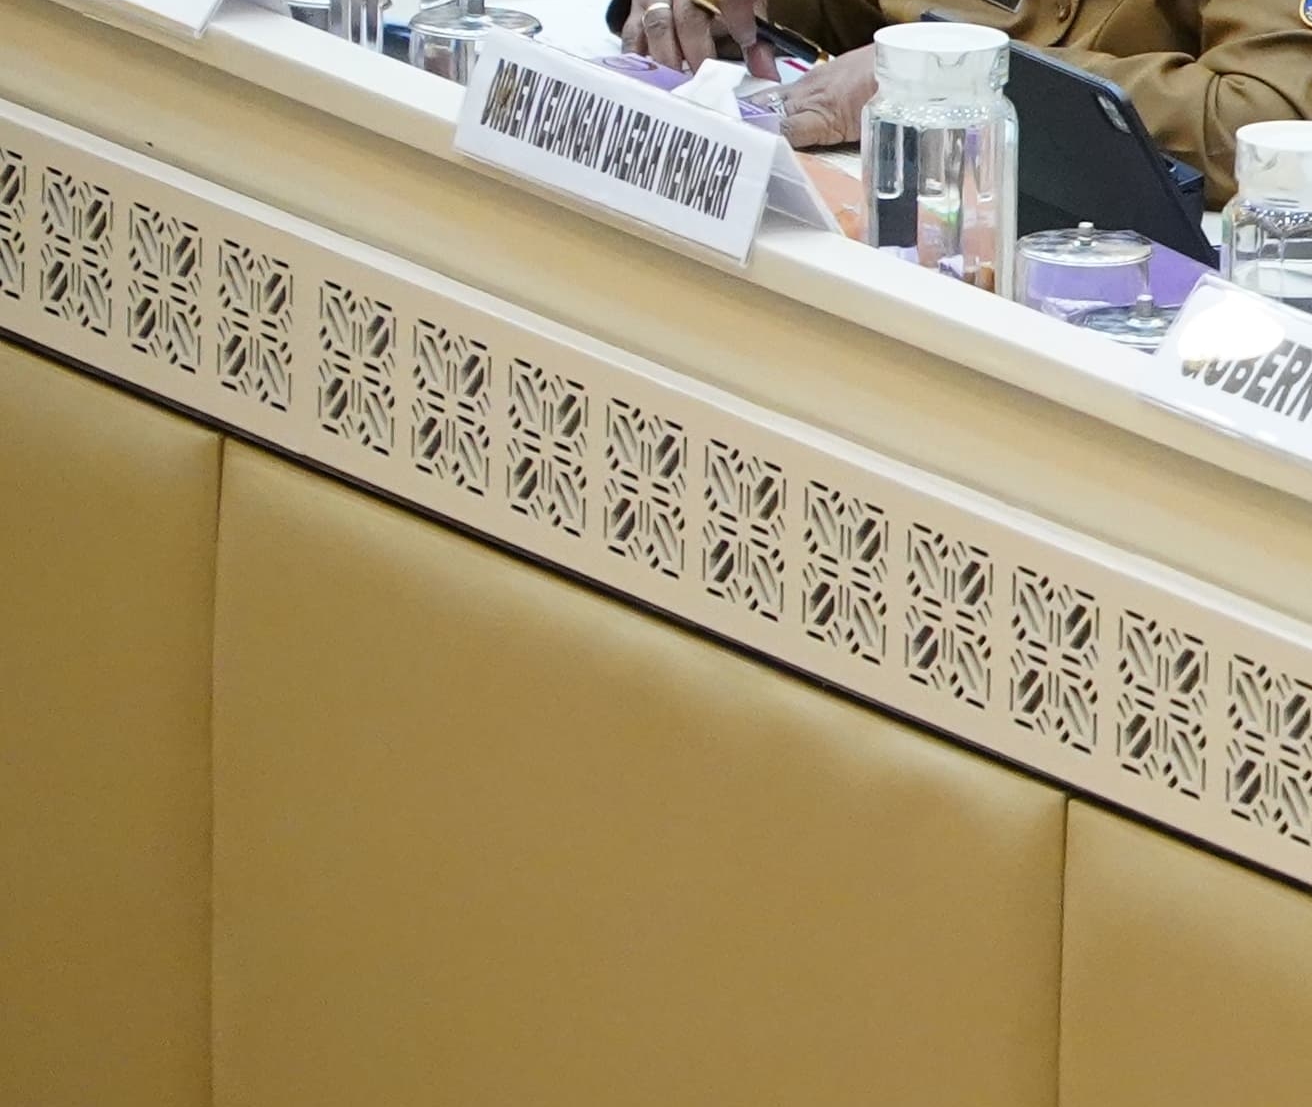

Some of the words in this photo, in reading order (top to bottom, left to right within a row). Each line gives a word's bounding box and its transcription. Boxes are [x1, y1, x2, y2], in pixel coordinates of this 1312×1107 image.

[527, 76, 614, 172] KEUANGAN
[599, 103, 670, 192] DAERAH
[656, 125, 743, 221] MENDAGRI
